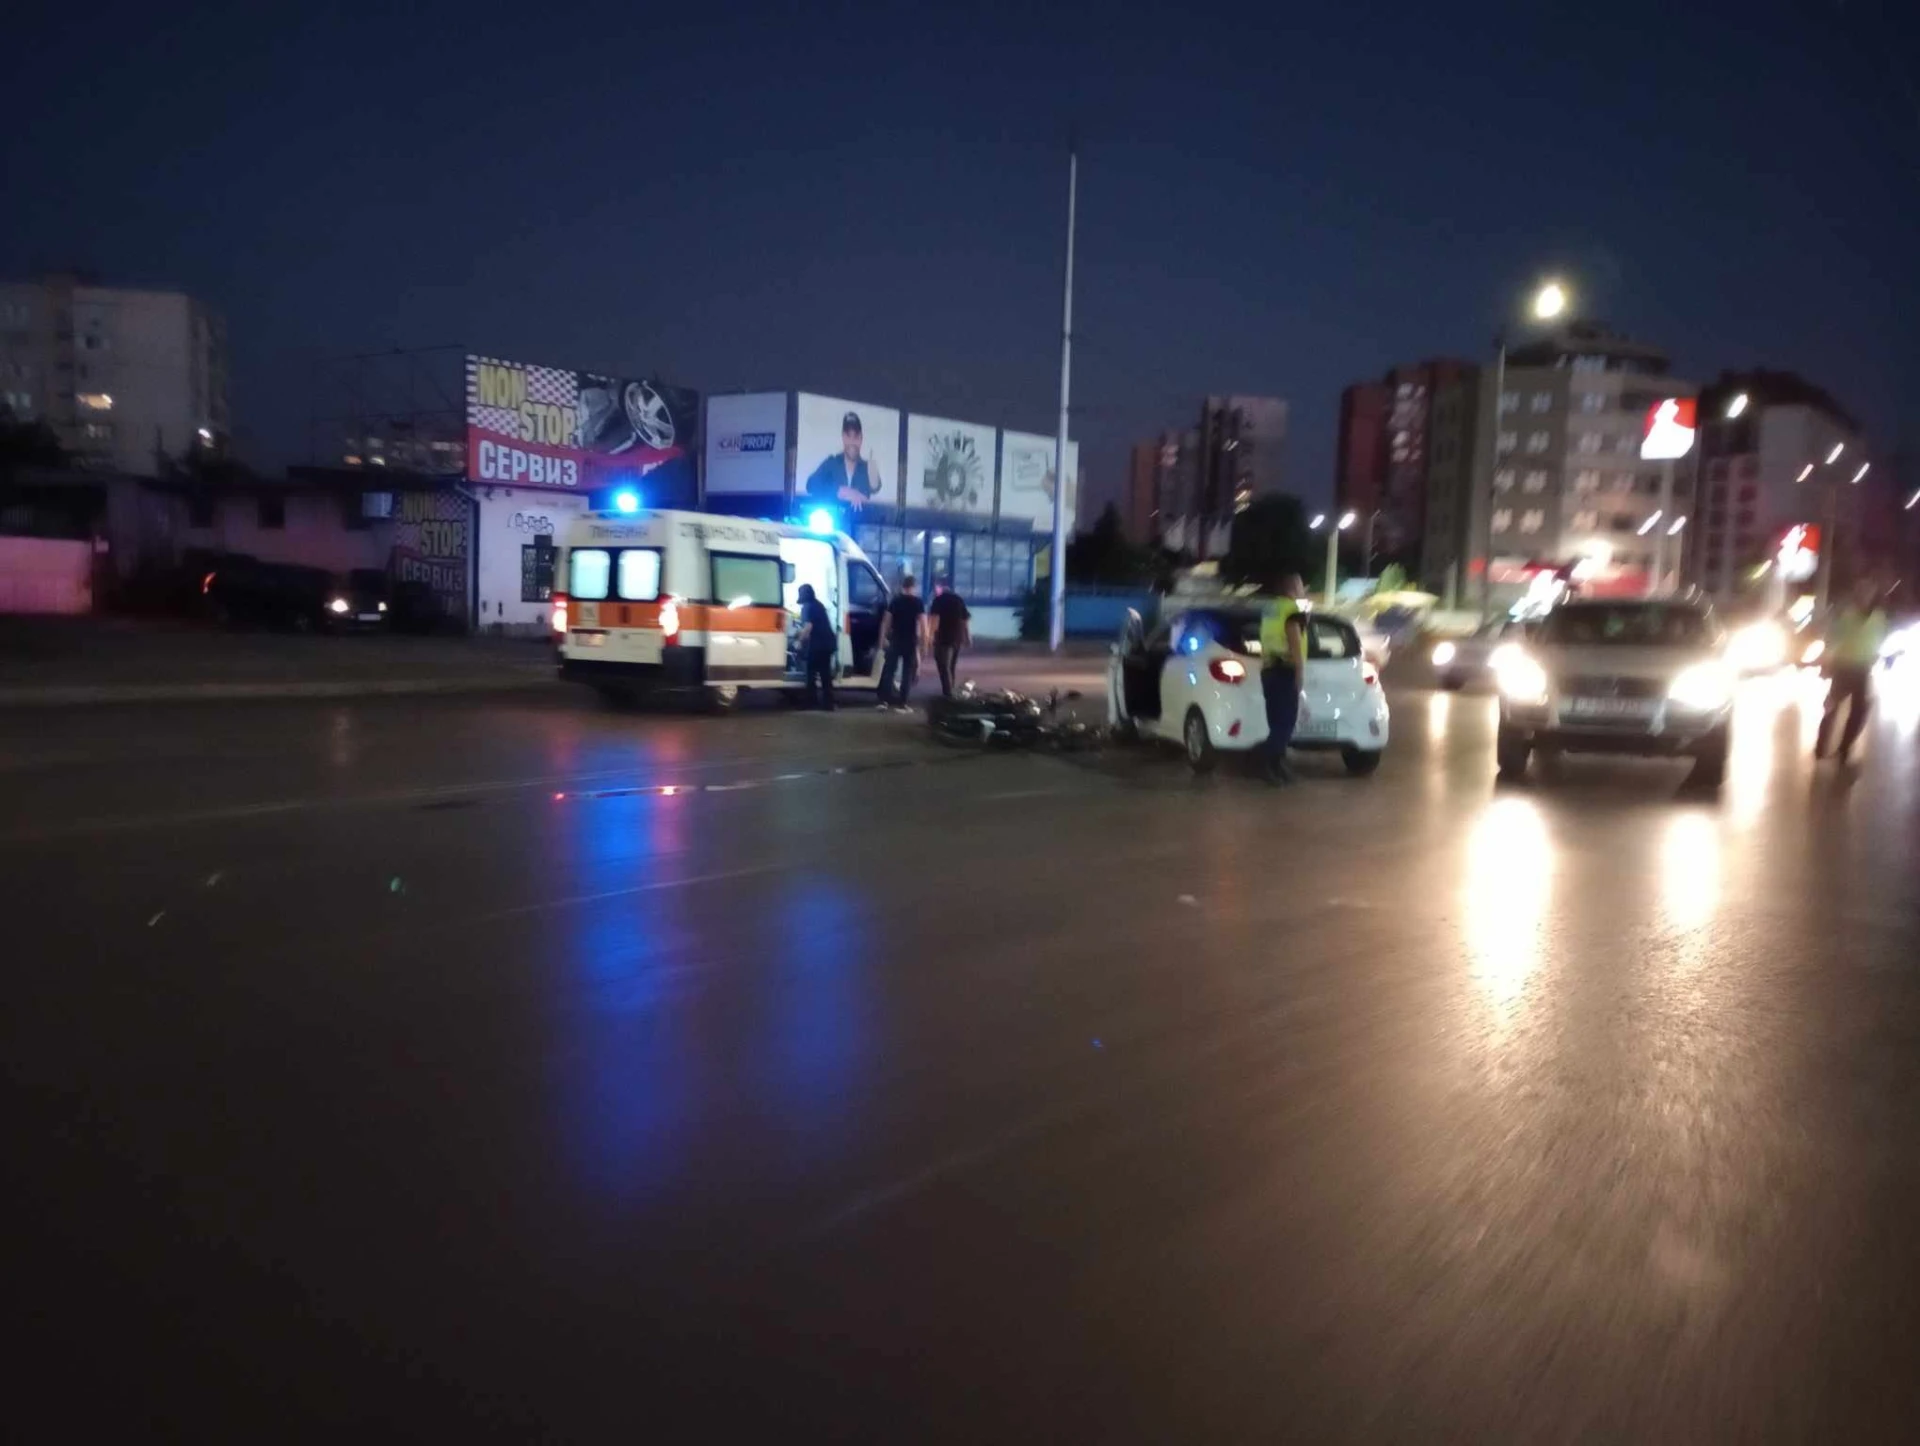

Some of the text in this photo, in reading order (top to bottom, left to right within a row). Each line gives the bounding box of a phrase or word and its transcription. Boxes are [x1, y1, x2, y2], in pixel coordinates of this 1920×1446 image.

[478, 362, 526, 410] NON
[519, 400, 576, 446] STOP
[479, 440, 578, 486] СЕРВИЗ
[420, 520, 463, 557] STOP
